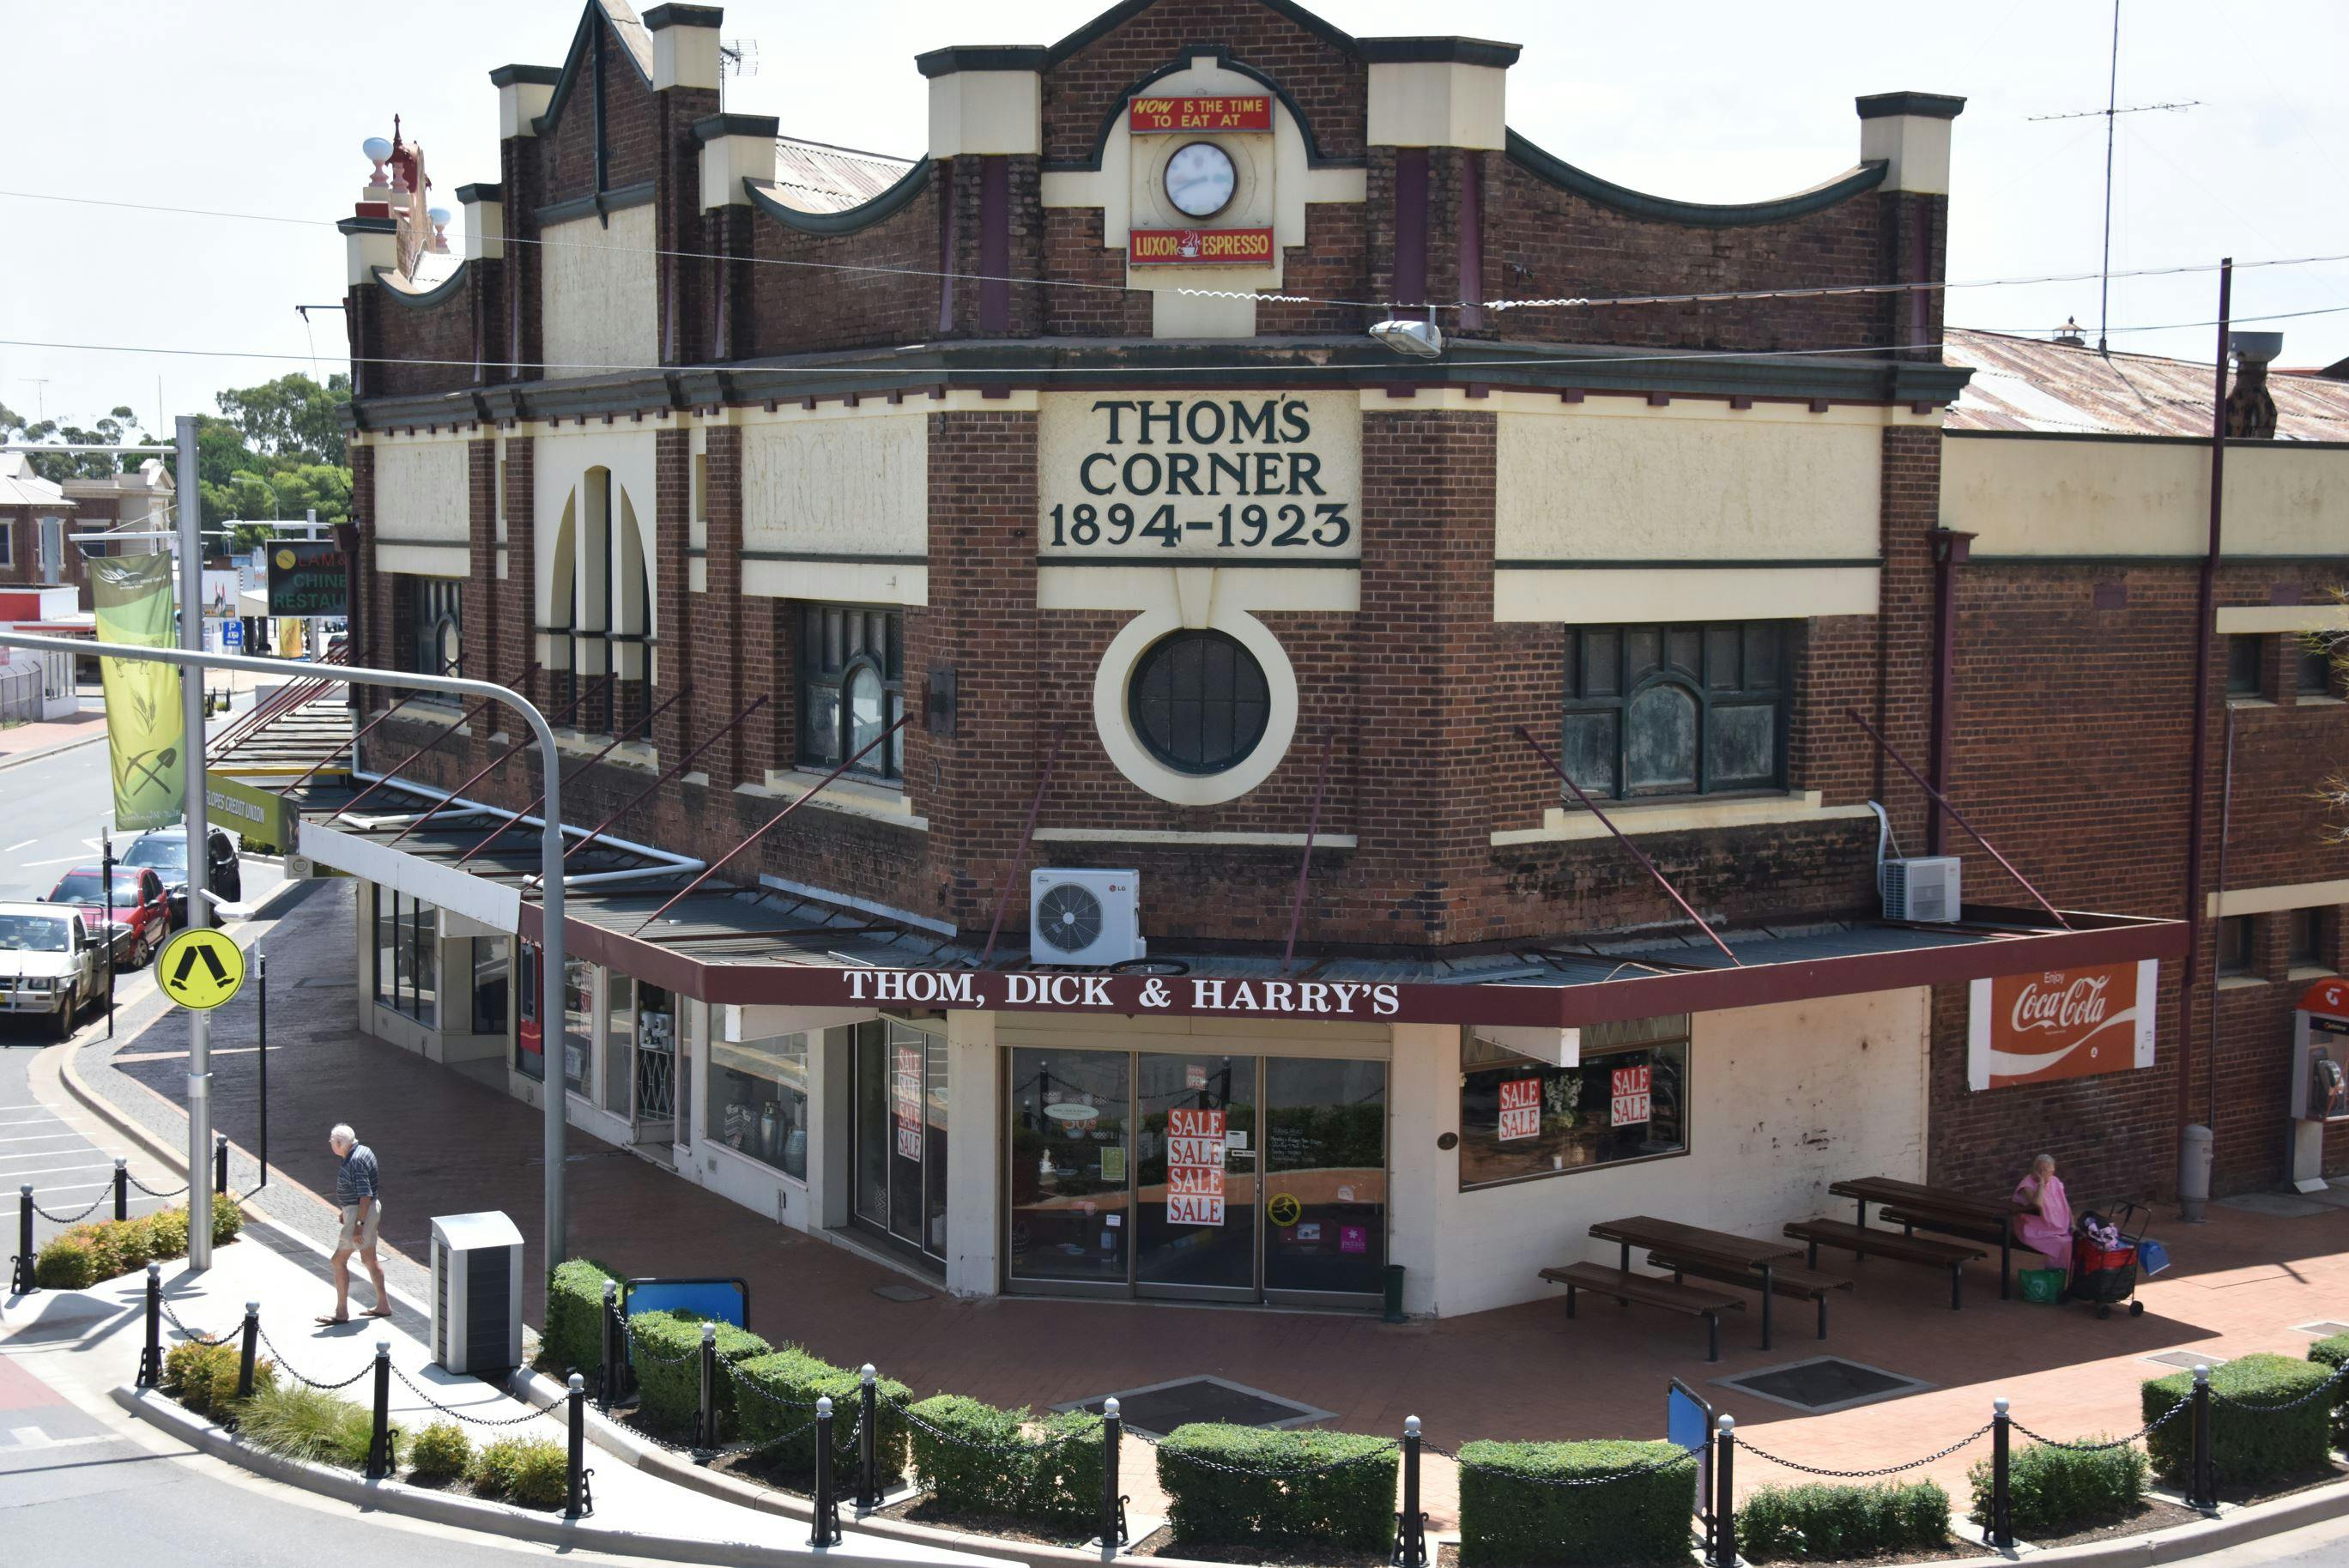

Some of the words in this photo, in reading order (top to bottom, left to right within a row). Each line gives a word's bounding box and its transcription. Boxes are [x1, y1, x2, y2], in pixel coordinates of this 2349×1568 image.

[1134, 100, 1174, 114] NOW
[1184, 100, 1194, 113] IS
[1199, 100, 1223, 113] THE
[1230, 100, 1263, 112] TIME
[1152, 115, 1172, 128] TO
[1181, 115, 1210, 127] EAT
[1220, 114, 1241, 126] AT
[1135, 237, 1178, 256] LUXOR
[1202, 234, 1269, 256] ESPRESSO
[1092, 393, 1311, 445] THOM'S
[1080, 452, 1327, 496] CORNER
[1050, 503, 1351, 548] 1894-1923
[228, 622, 236, 631] P
[226, 796, 245, 817] CREDIT
[245, 802, 264, 824] UNION
[2043, 972, 2065, 984] Enjoy
[844, 971, 985, 1008] THOM,
[1004, 974, 1114, 1006] DICK
[1139, 978, 1171, 1008] &
[1191, 979, 1400, 1015] HARRY'S
[899, 1050, 920, 1076] SALE
[899, 1076, 920, 1105] SALE
[1502, 1081, 1538, 1110] SALE
[1613, 1069, 1649, 1096] SALE
[899, 1105, 920, 1131] SALE
[1501, 1109, 1538, 1138] SALE
[1613, 1096, 1648, 1124] SALE
[1171, 1111, 1223, 1138] SALE
[899, 1130, 920, 1159] SALE
[1171, 1139, 1222, 1165] SALE
[1170, 1167, 1222, 1195] SALE
[1170, 1196, 1221, 1224] SALE
